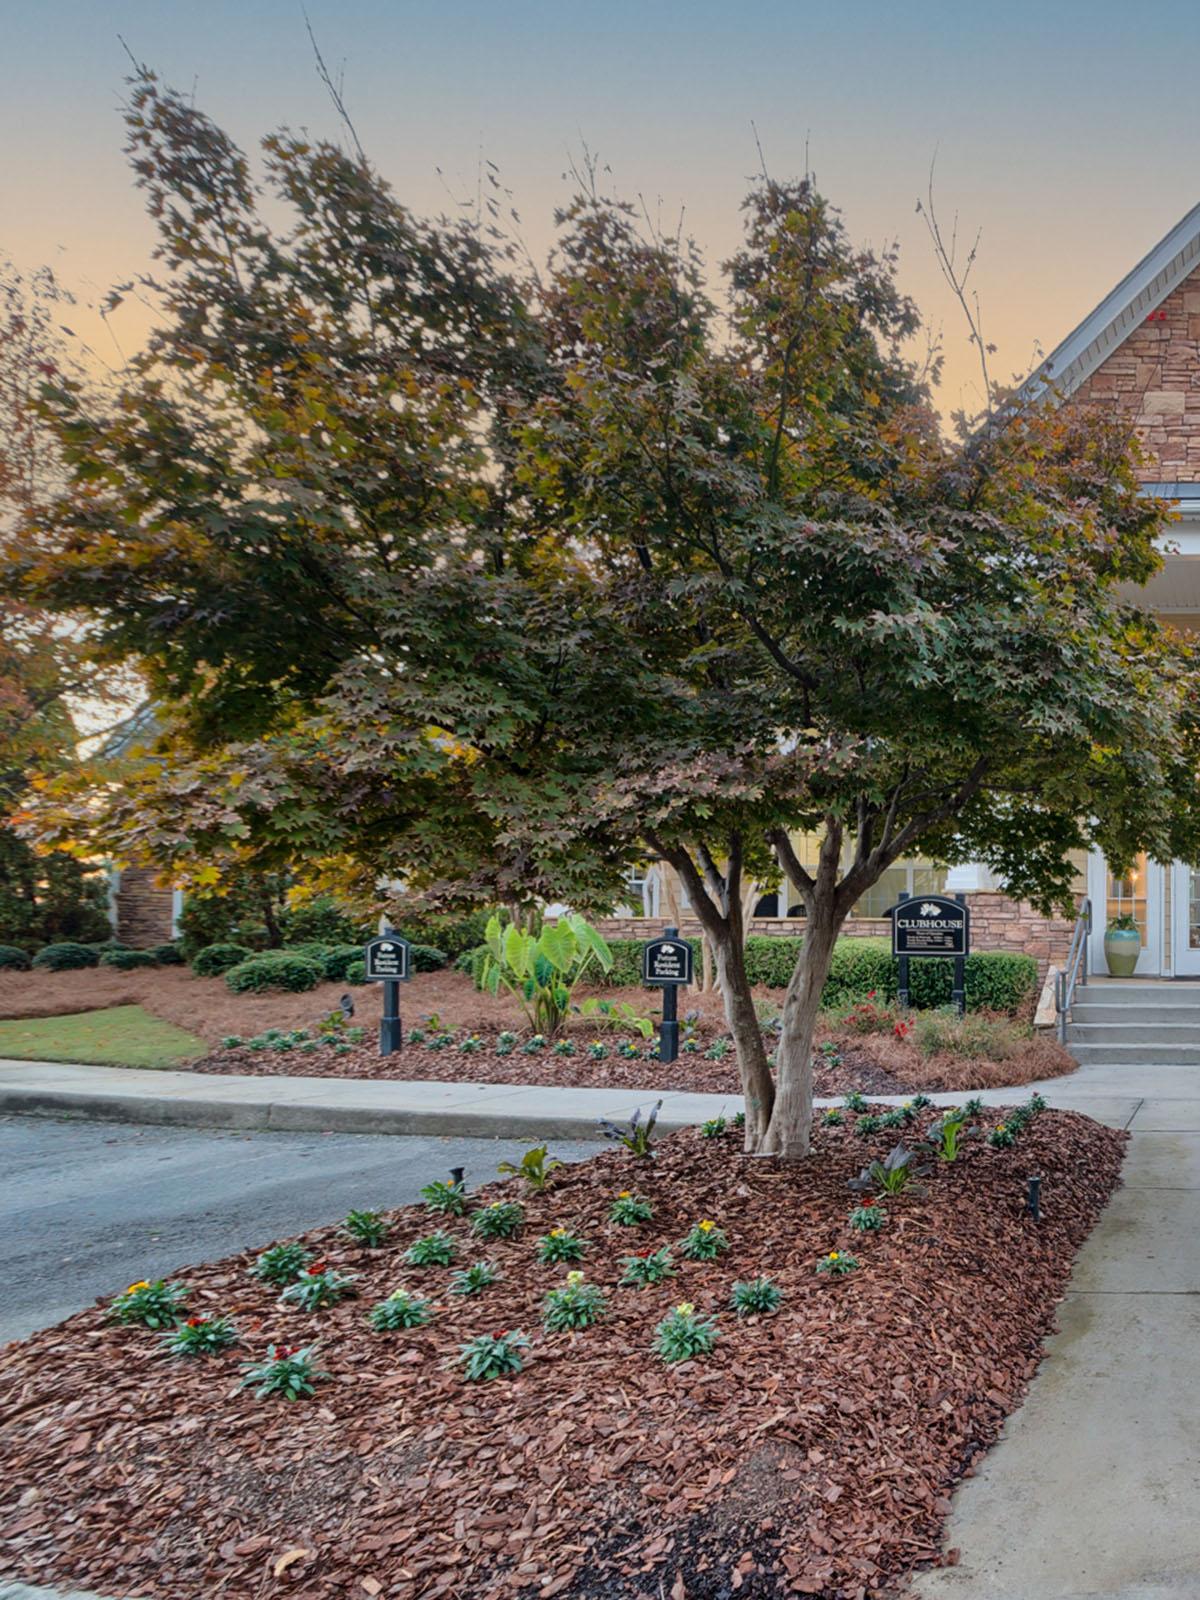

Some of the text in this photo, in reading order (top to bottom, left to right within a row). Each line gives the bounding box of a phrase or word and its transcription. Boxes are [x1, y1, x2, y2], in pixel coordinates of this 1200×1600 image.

[897, 919, 964, 929] CLUBHOUSE
[654, 961, 681, 969] Resident
[655, 968, 680, 977] Parking
